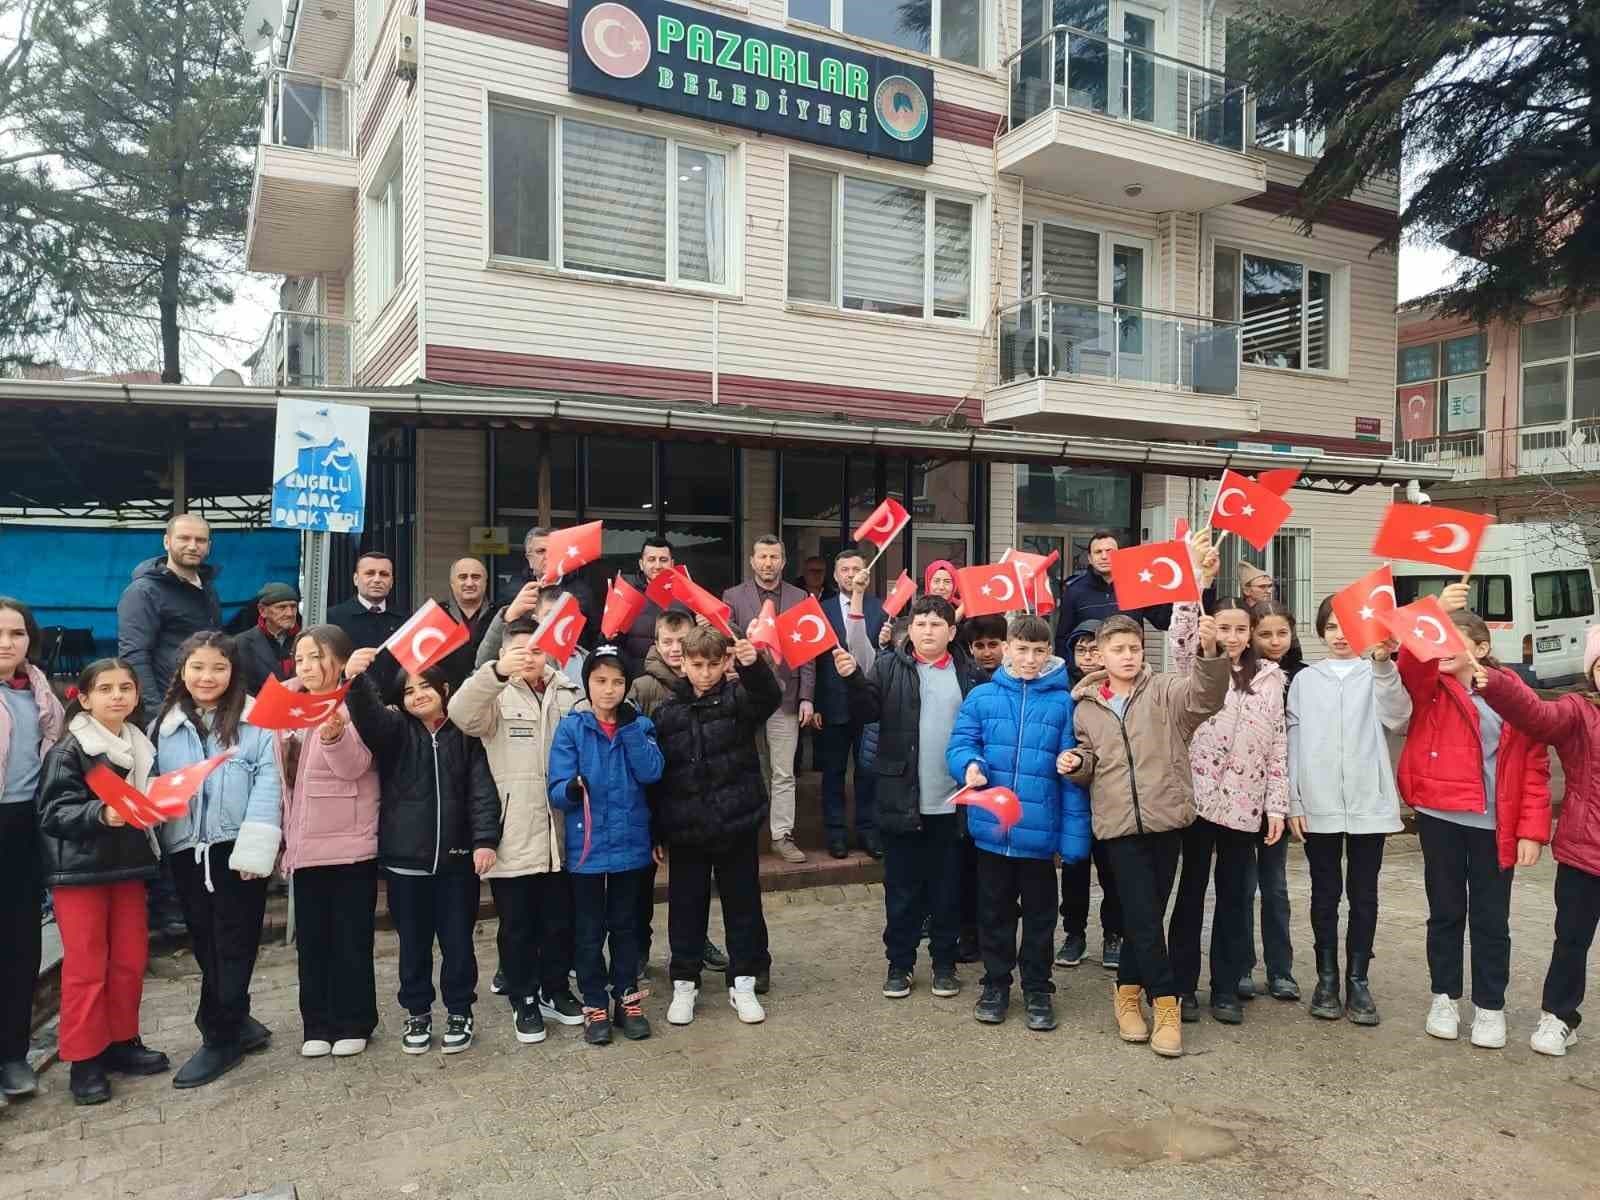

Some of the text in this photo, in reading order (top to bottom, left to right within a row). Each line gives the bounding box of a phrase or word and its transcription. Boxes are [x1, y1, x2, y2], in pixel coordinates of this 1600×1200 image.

[657, 14, 869, 101] PAZARLAR
[658, 66, 868, 134] BELEDİYESİ
[296, 492, 341, 511] ARAÇ
